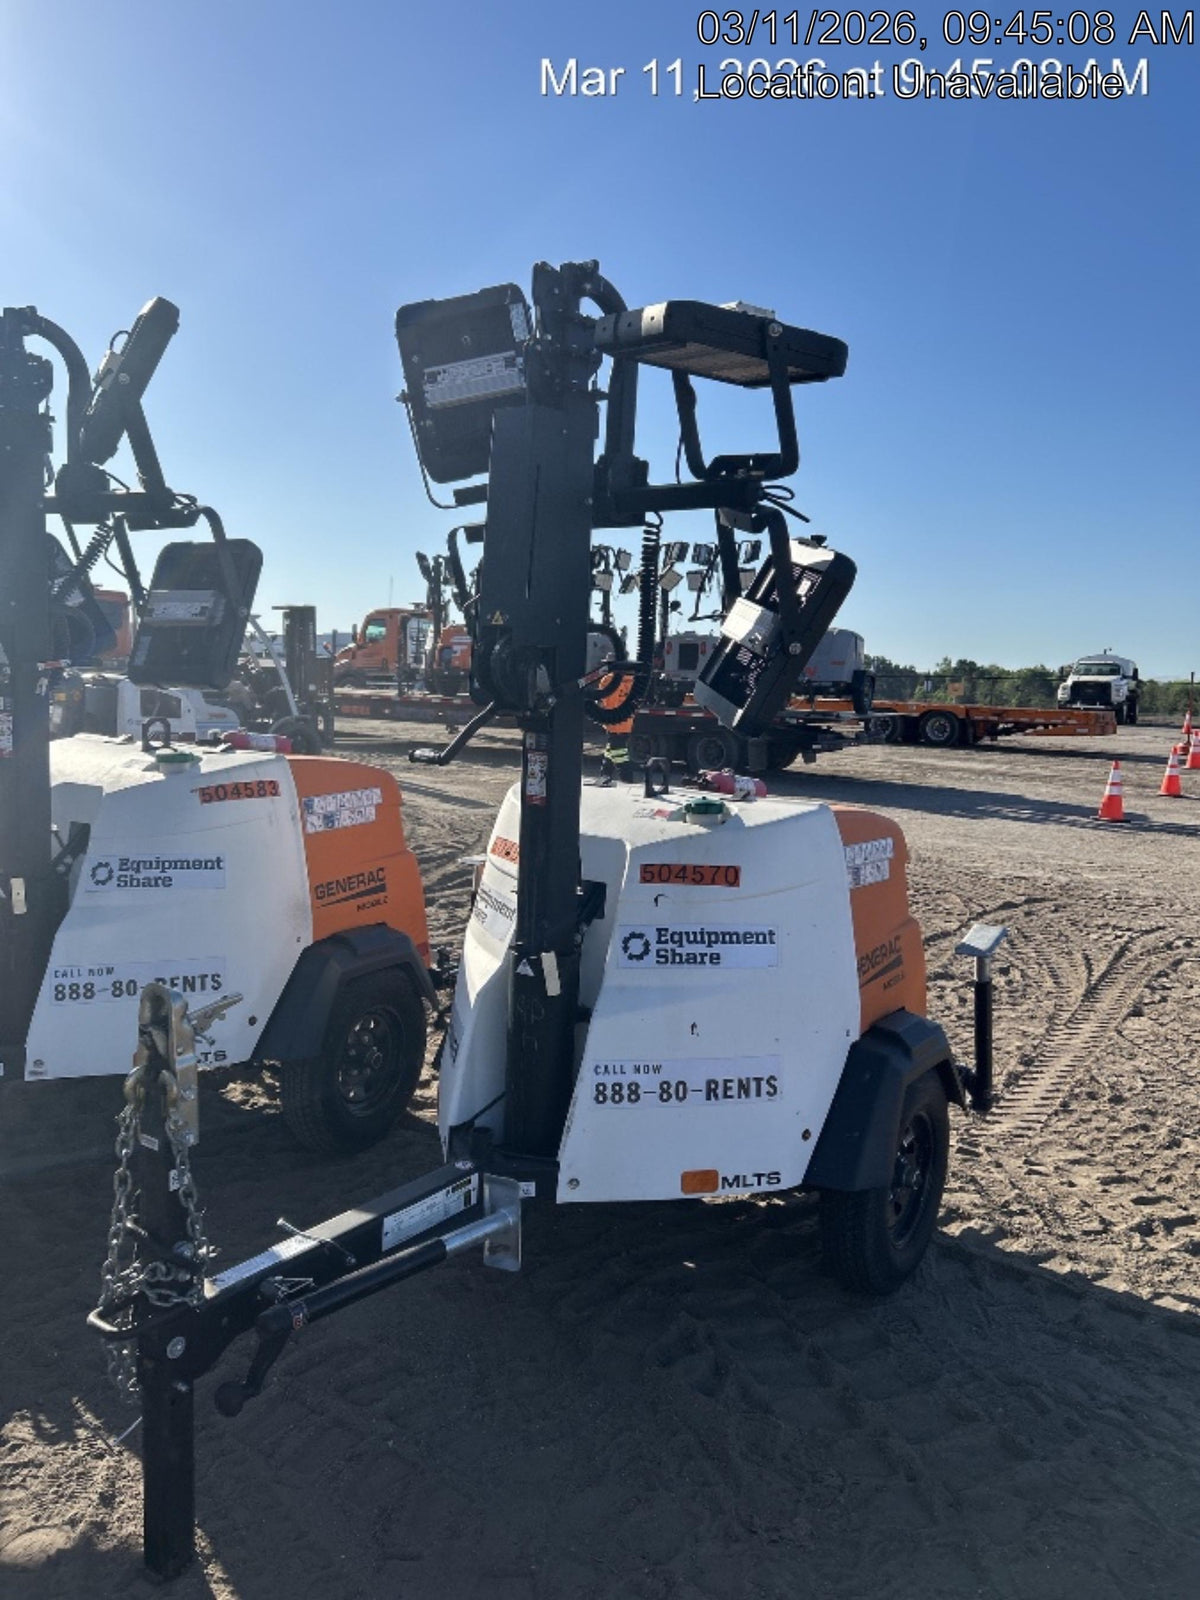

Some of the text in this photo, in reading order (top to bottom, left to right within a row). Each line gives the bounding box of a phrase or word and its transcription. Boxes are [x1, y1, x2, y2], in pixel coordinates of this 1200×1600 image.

[201, 780, 279, 804] 504583
[117, 856, 224, 875] Equipment
[641, 864, 740, 886] 504570
[116, 874, 173, 889] Share
[314, 867, 387, 900] GENERAC
[655, 928, 776, 949] Equipment
[655, 949, 721, 966] Share
[53, 966, 115, 979] CALL NOW
[593, 1064, 663, 1076] CALL NOW
[593, 1075, 779, 1105] 888-80-RENTS
[720, 1172, 782, 1190] MLTS
